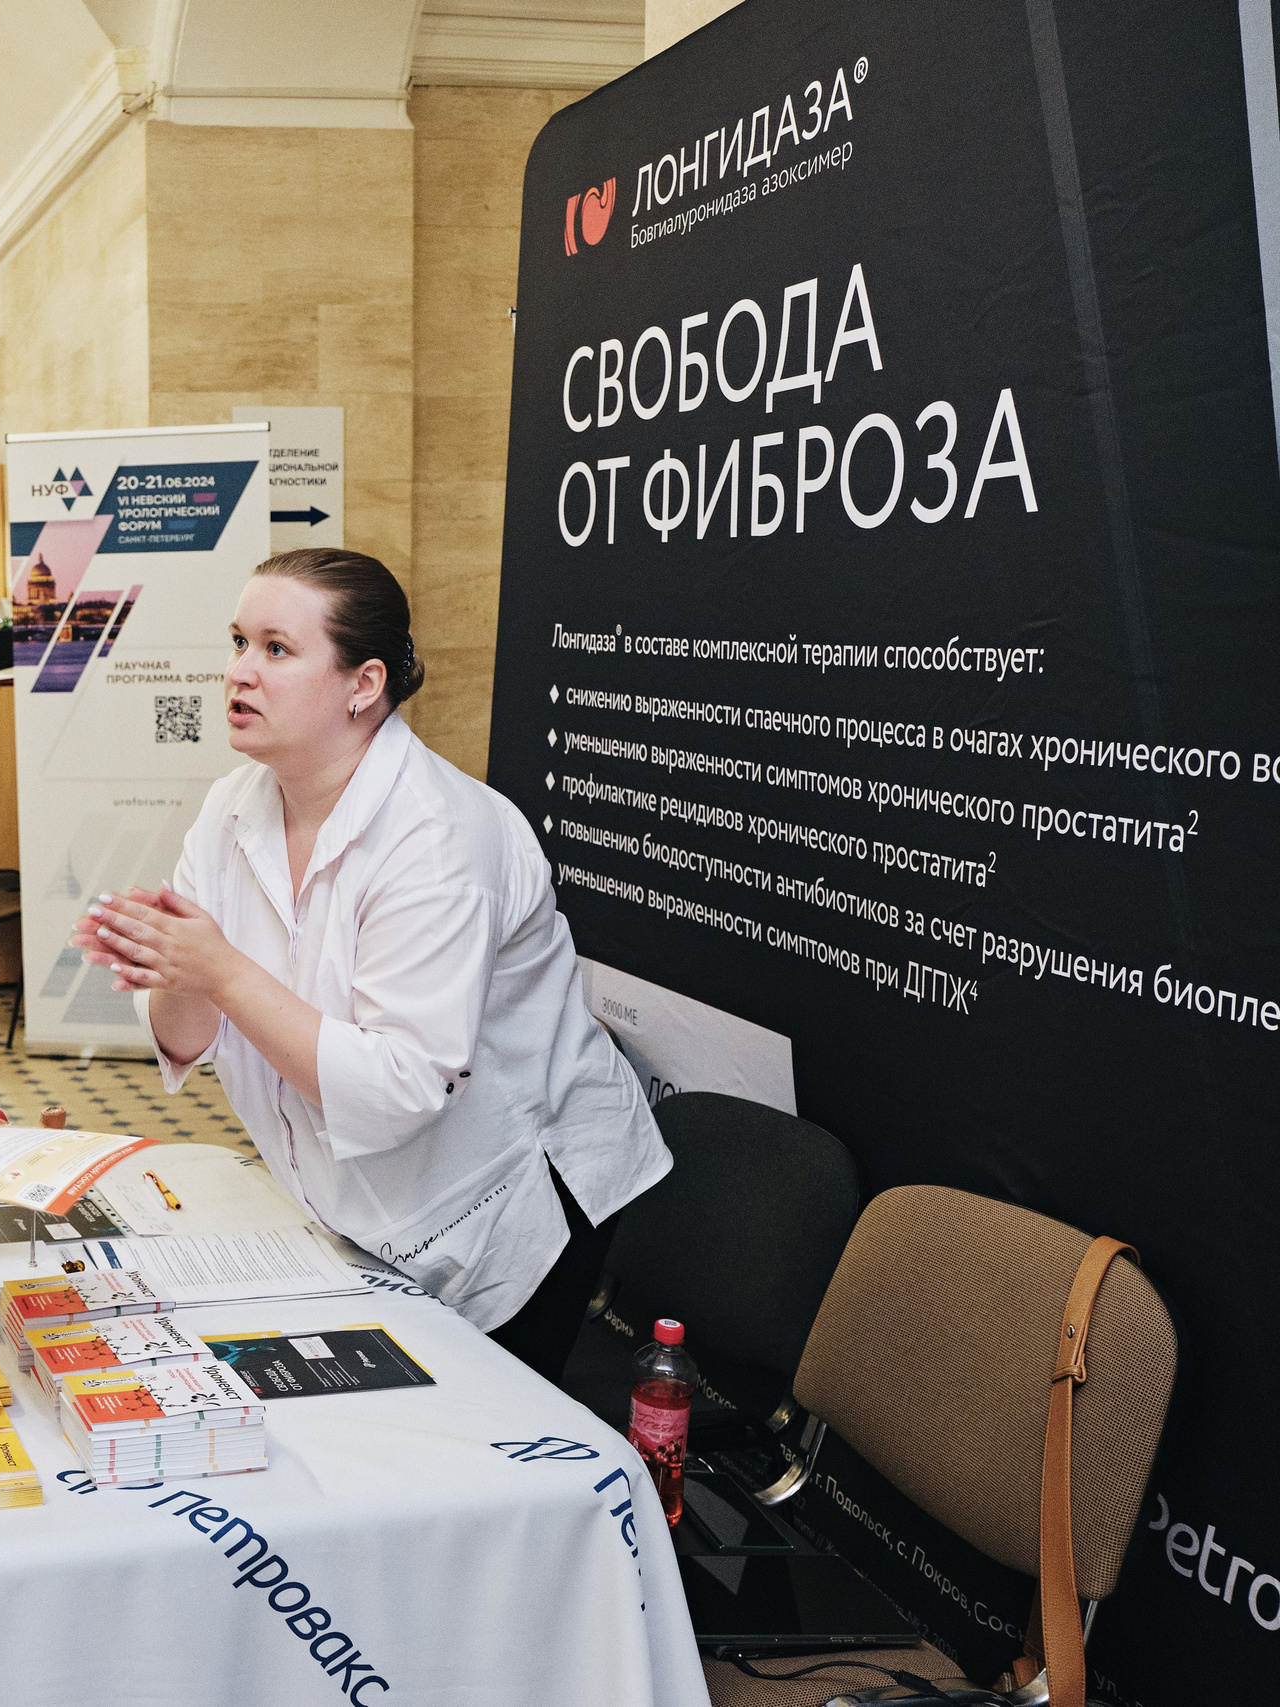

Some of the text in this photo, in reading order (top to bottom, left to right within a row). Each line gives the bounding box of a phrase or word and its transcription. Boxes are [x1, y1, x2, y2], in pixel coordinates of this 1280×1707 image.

[629, 140, 854, 249] Бовгиалуронидаза азоксимер
[562, 263, 883, 433] СВОБОДА
[117, 474, 216, 491] 20-21.06.2024
[558, 387, 1039, 547] ОТ ФИБРОЗА
[31, 484, 70, 497] НУФ
[117, 492, 187, 506] VI НЕВСКИЙ
[117, 505, 220, 519] УРОЛОГИЧЕСКИЙ
[117, 519, 162, 532] ФОРУМ
[118, 533, 196, 544] САНКТ-ПЕТЕРБУРГ
[106, 674, 182, 684] ПРОГРАММА
[115, 661, 170, 670] НАУЧНАЯ
[624, 636, 632, 654] в
[635, 635, 689, 658] составе
[692, 634, 798, 664] комплексной
[802, 643, 878, 673] терапии
[883, 636, 1045, 682] способствует:
[565, 685, 632, 712] снижению
[634, 694, 741, 727] выраженности
[745, 706, 831, 738] спаечного
[835, 716, 926, 748] процесса
[932, 726, 943, 748] в
[949, 727, 1023, 759] очагах
[1030, 734, 1241, 780] хронического
[563, 730, 647, 762] уменьшению
[650, 745, 761, 783] выраженности
[766, 763, 862, 800] симптомов
[867, 779, 1015, 825] хронического
[562, 773, 657, 812] профилактике
[659, 797, 744, 831] рецидивов
[748, 812, 867, 861] хронического
[559, 816, 639, 856] повышению
[642, 832, 772, 893] биодоступности
[776, 876, 899, 929] антибиотиков
[904, 908, 925, 936] за
[930, 915, 977, 950] счет
[982, 928, 1143, 997] разрушения
[557, 860, 644, 905] уменьшению
[647, 891, 762, 943] выраженности
[767, 924, 861, 975] симптомов
[864, 956, 899, 997] при
[602, 997, 623, 1019] 3000
[380, 1234, 439, 1265] Cruise
[445, 1210, 472, 1232] TWINKLE
[473, 1202, 483, 1211] OF
[154, 1316, 193, 1348] Уронекст
[202, 1364, 243, 1401] Уронекст
[0, 1442, 18, 1468] Уронекст
[826, 1475, 894, 1551] Подольск,
[911, 1545, 972, 1617] Покров,
[974, 1601, 1024, 1643] Сос
[148, 1490, 391, 1707] Петровакс
